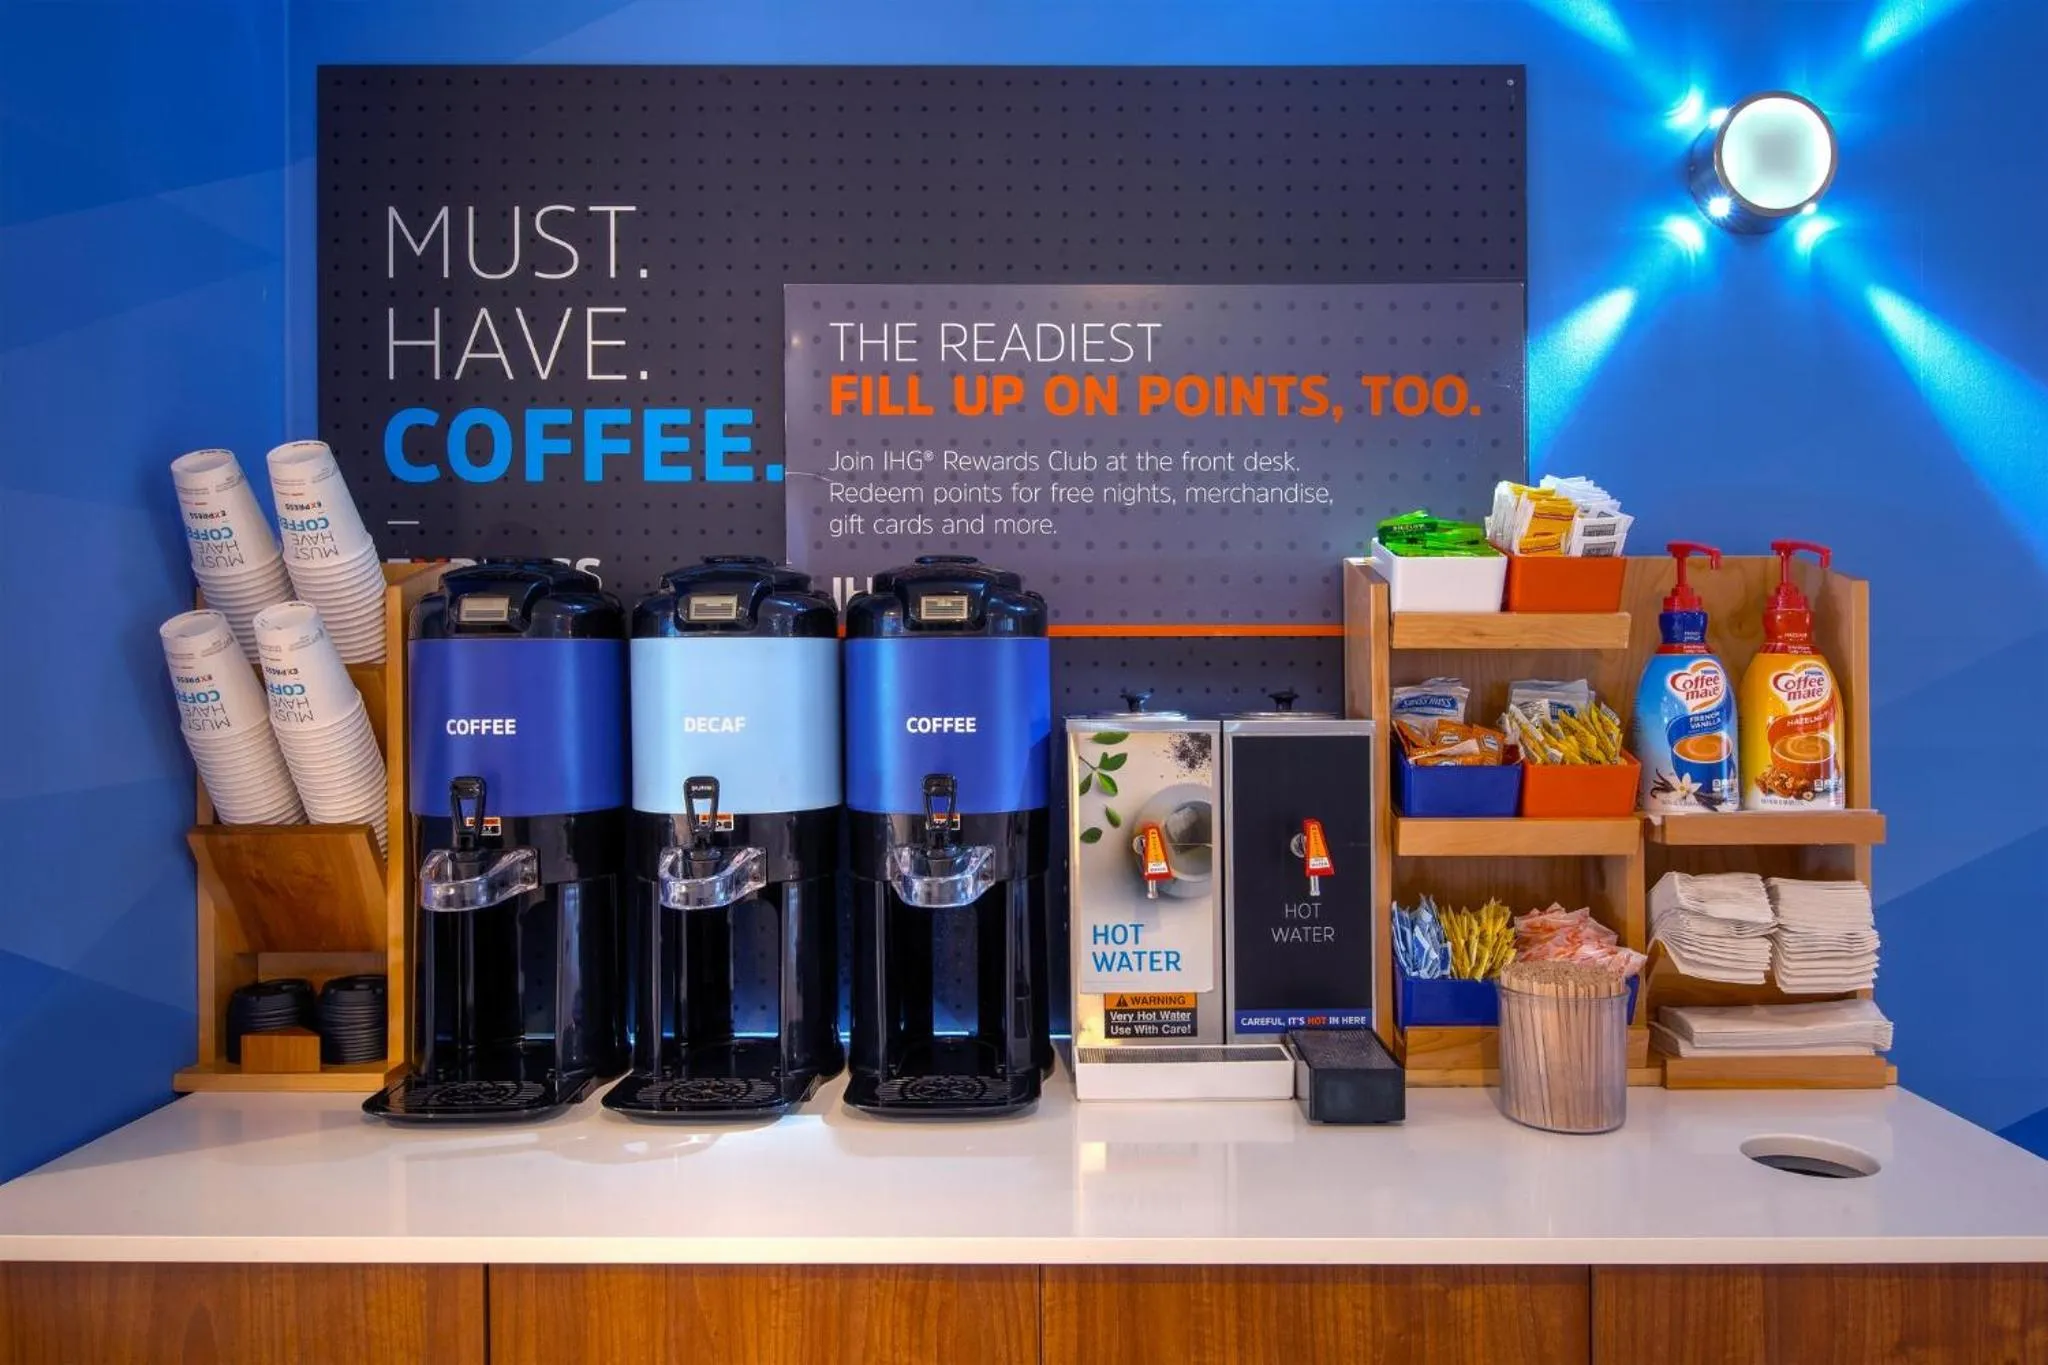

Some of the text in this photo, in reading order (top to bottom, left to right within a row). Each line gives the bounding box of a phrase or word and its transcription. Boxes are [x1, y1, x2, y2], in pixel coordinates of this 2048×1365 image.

[388, 204, 648, 280] MUST.
[388, 307, 648, 381] HAVE.
[829, 322, 1163, 363] THE READIEST
[831, 375, 1483, 424] FILL UP ON POINTS, TOO.
[383, 407, 784, 483] COFFEE.
[828, 450, 874, 472] Join
[943, 450, 1040, 472] Rewards
[1048, 450, 1098, 472] Club
[1105, 452, 1128, 472] at
[1136, 451, 1173, 472] the
[1182, 450, 1235, 472] front
[1243, 450, 1300, 472] desk.
[829, 482, 1334, 506] Redeem points for free nights, merchandise,
[829, 513, 1057, 538] gift cards and more.
[1670, 672, 1720, 692] Coffee
[1772, 672, 1825, 693] Coffee
[1686, 686, 1719, 700] mate
[1787, 687, 1824, 701] mate
[446, 718, 517, 736] COFFEE
[684, 716, 746, 733] DECAF
[906, 716, 977, 734] COFFEE
[1285, 902, 1322, 920] HOT
[1092, 923, 1145, 946] HOT
[1270, 926, 1335, 943] WATER
[1091, 950, 1182, 972] WATER
[1131, 994, 1186, 1006] WARNING
[1110, 1009, 1191, 1024] Very Hot Water
[1240, 1015, 1366, 1027] CAREFUL, IT'S HOT IN HERE
[1110, 1022, 1191, 1036] Use With Care!
